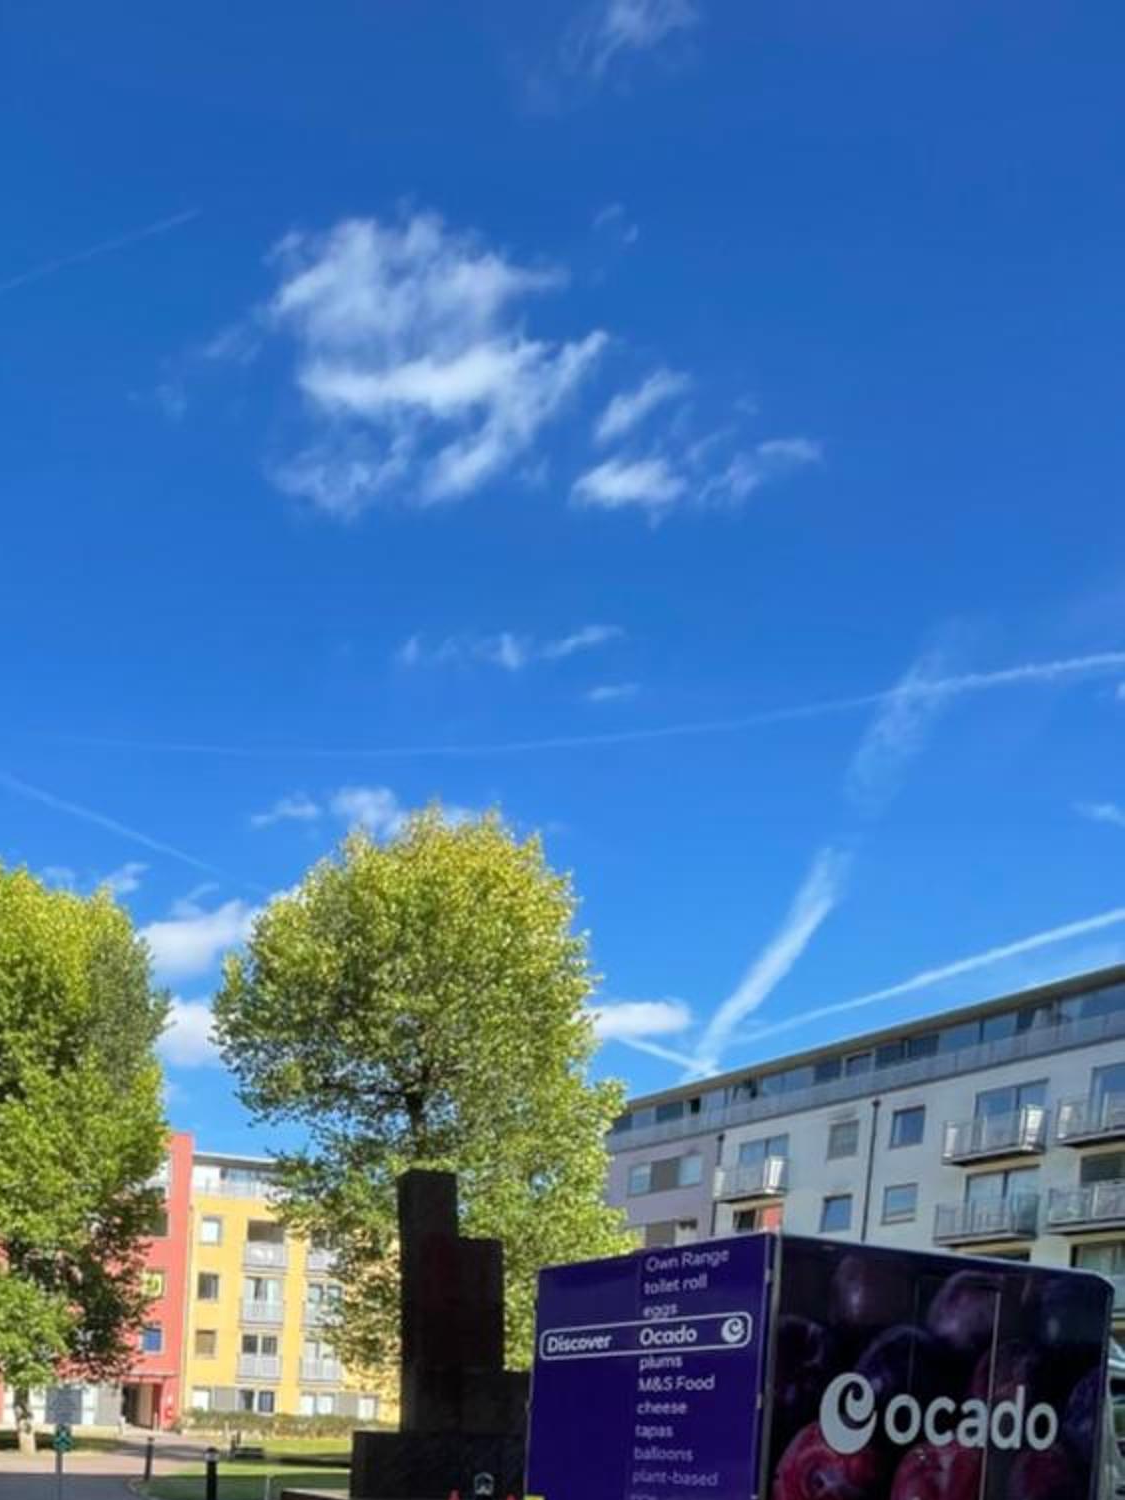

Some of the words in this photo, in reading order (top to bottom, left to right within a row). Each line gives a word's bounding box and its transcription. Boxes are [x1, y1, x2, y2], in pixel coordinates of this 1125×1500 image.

[645, 1256, 679, 1272] Own
[681, 1250, 729, 1268] Range
[644, 1278, 680, 1295] toilet
[682, 1273, 707, 1290] roll
[643, 1303, 678, 1319] eggs
[547, 1334, 612, 1353] Discover
[640, 1325, 697, 1346] Ocado
[639, 1355, 683, 1371] plums
[637, 1376, 673, 1391] M&S
[676, 1375, 715, 1391] Food
[637, 1400, 688, 1415] cheese
[884, 1384, 1059, 1451] ocado
[635, 1424, 674, 1440] tapas
[633, 1447, 694, 1462] balloons
[632, 1469, 719, 1487] plant-based
